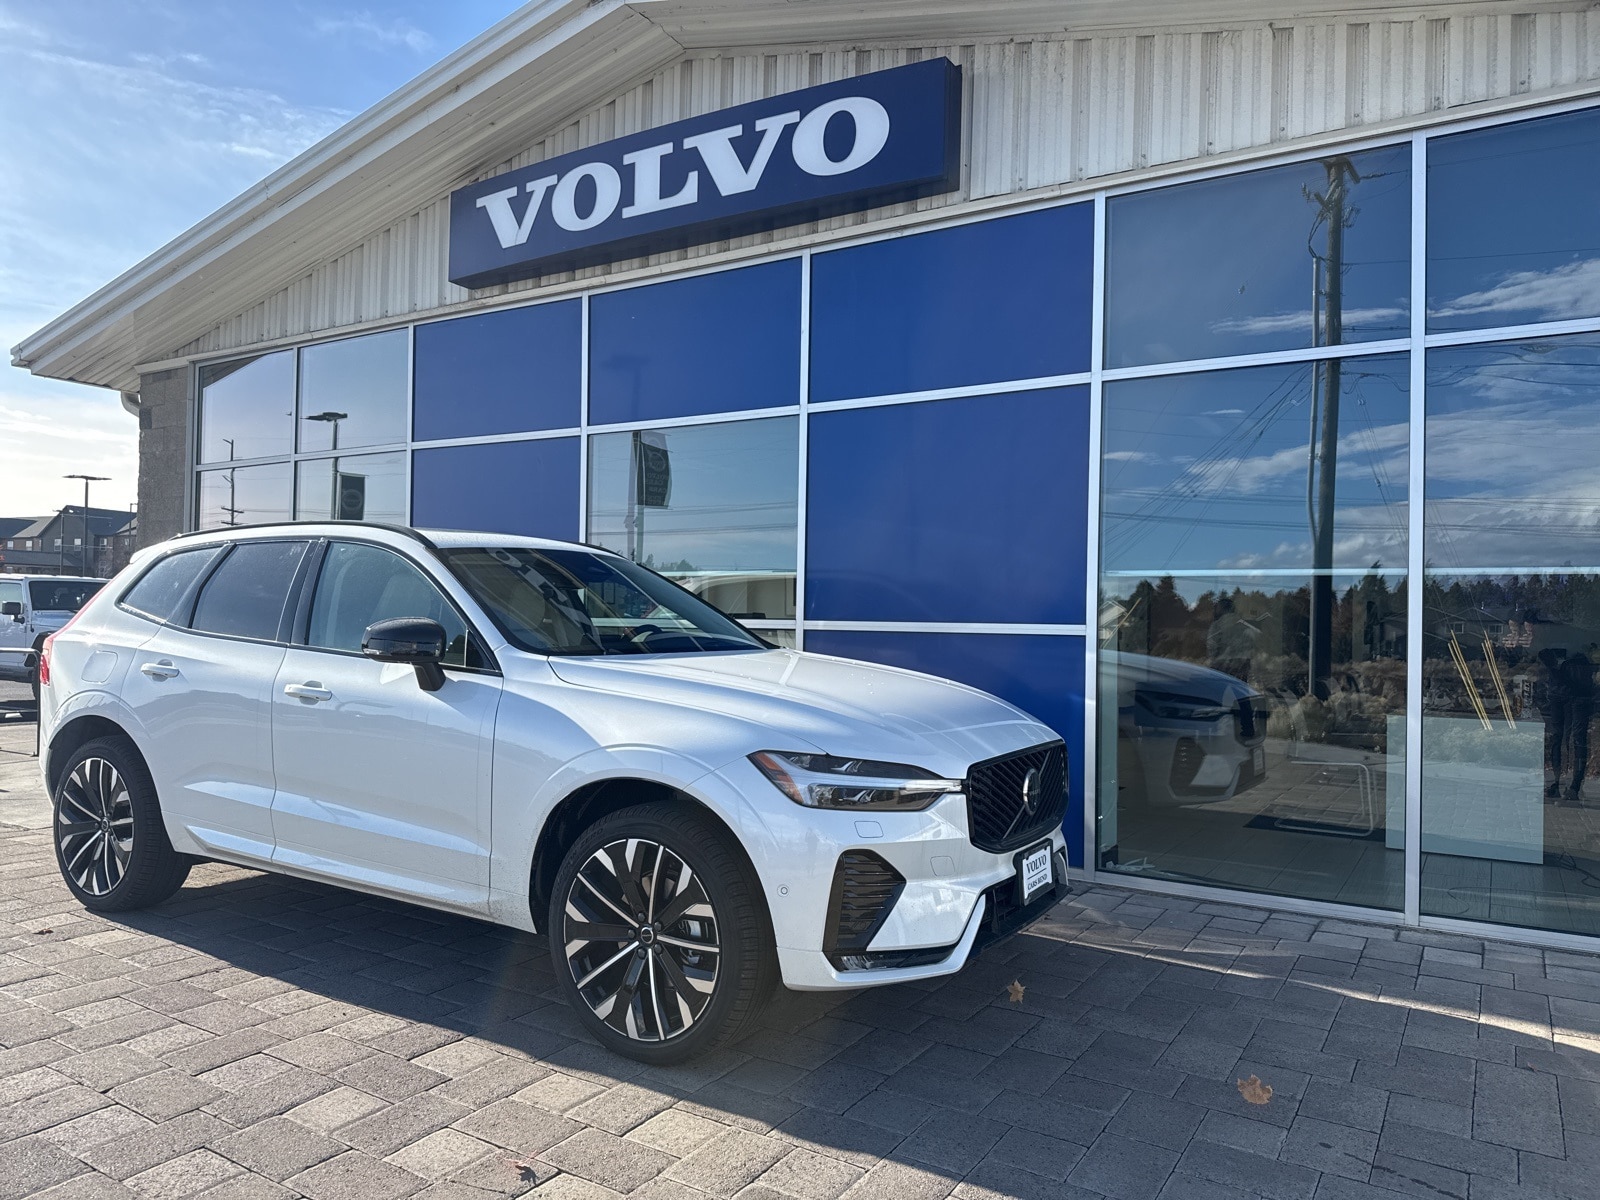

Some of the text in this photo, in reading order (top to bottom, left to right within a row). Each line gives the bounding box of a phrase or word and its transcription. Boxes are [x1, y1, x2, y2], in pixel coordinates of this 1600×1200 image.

[476, 96, 890, 249] VOLVO
[1026, 854, 1047, 874] VOLVO
[1027, 880, 1038, 890] CARS
